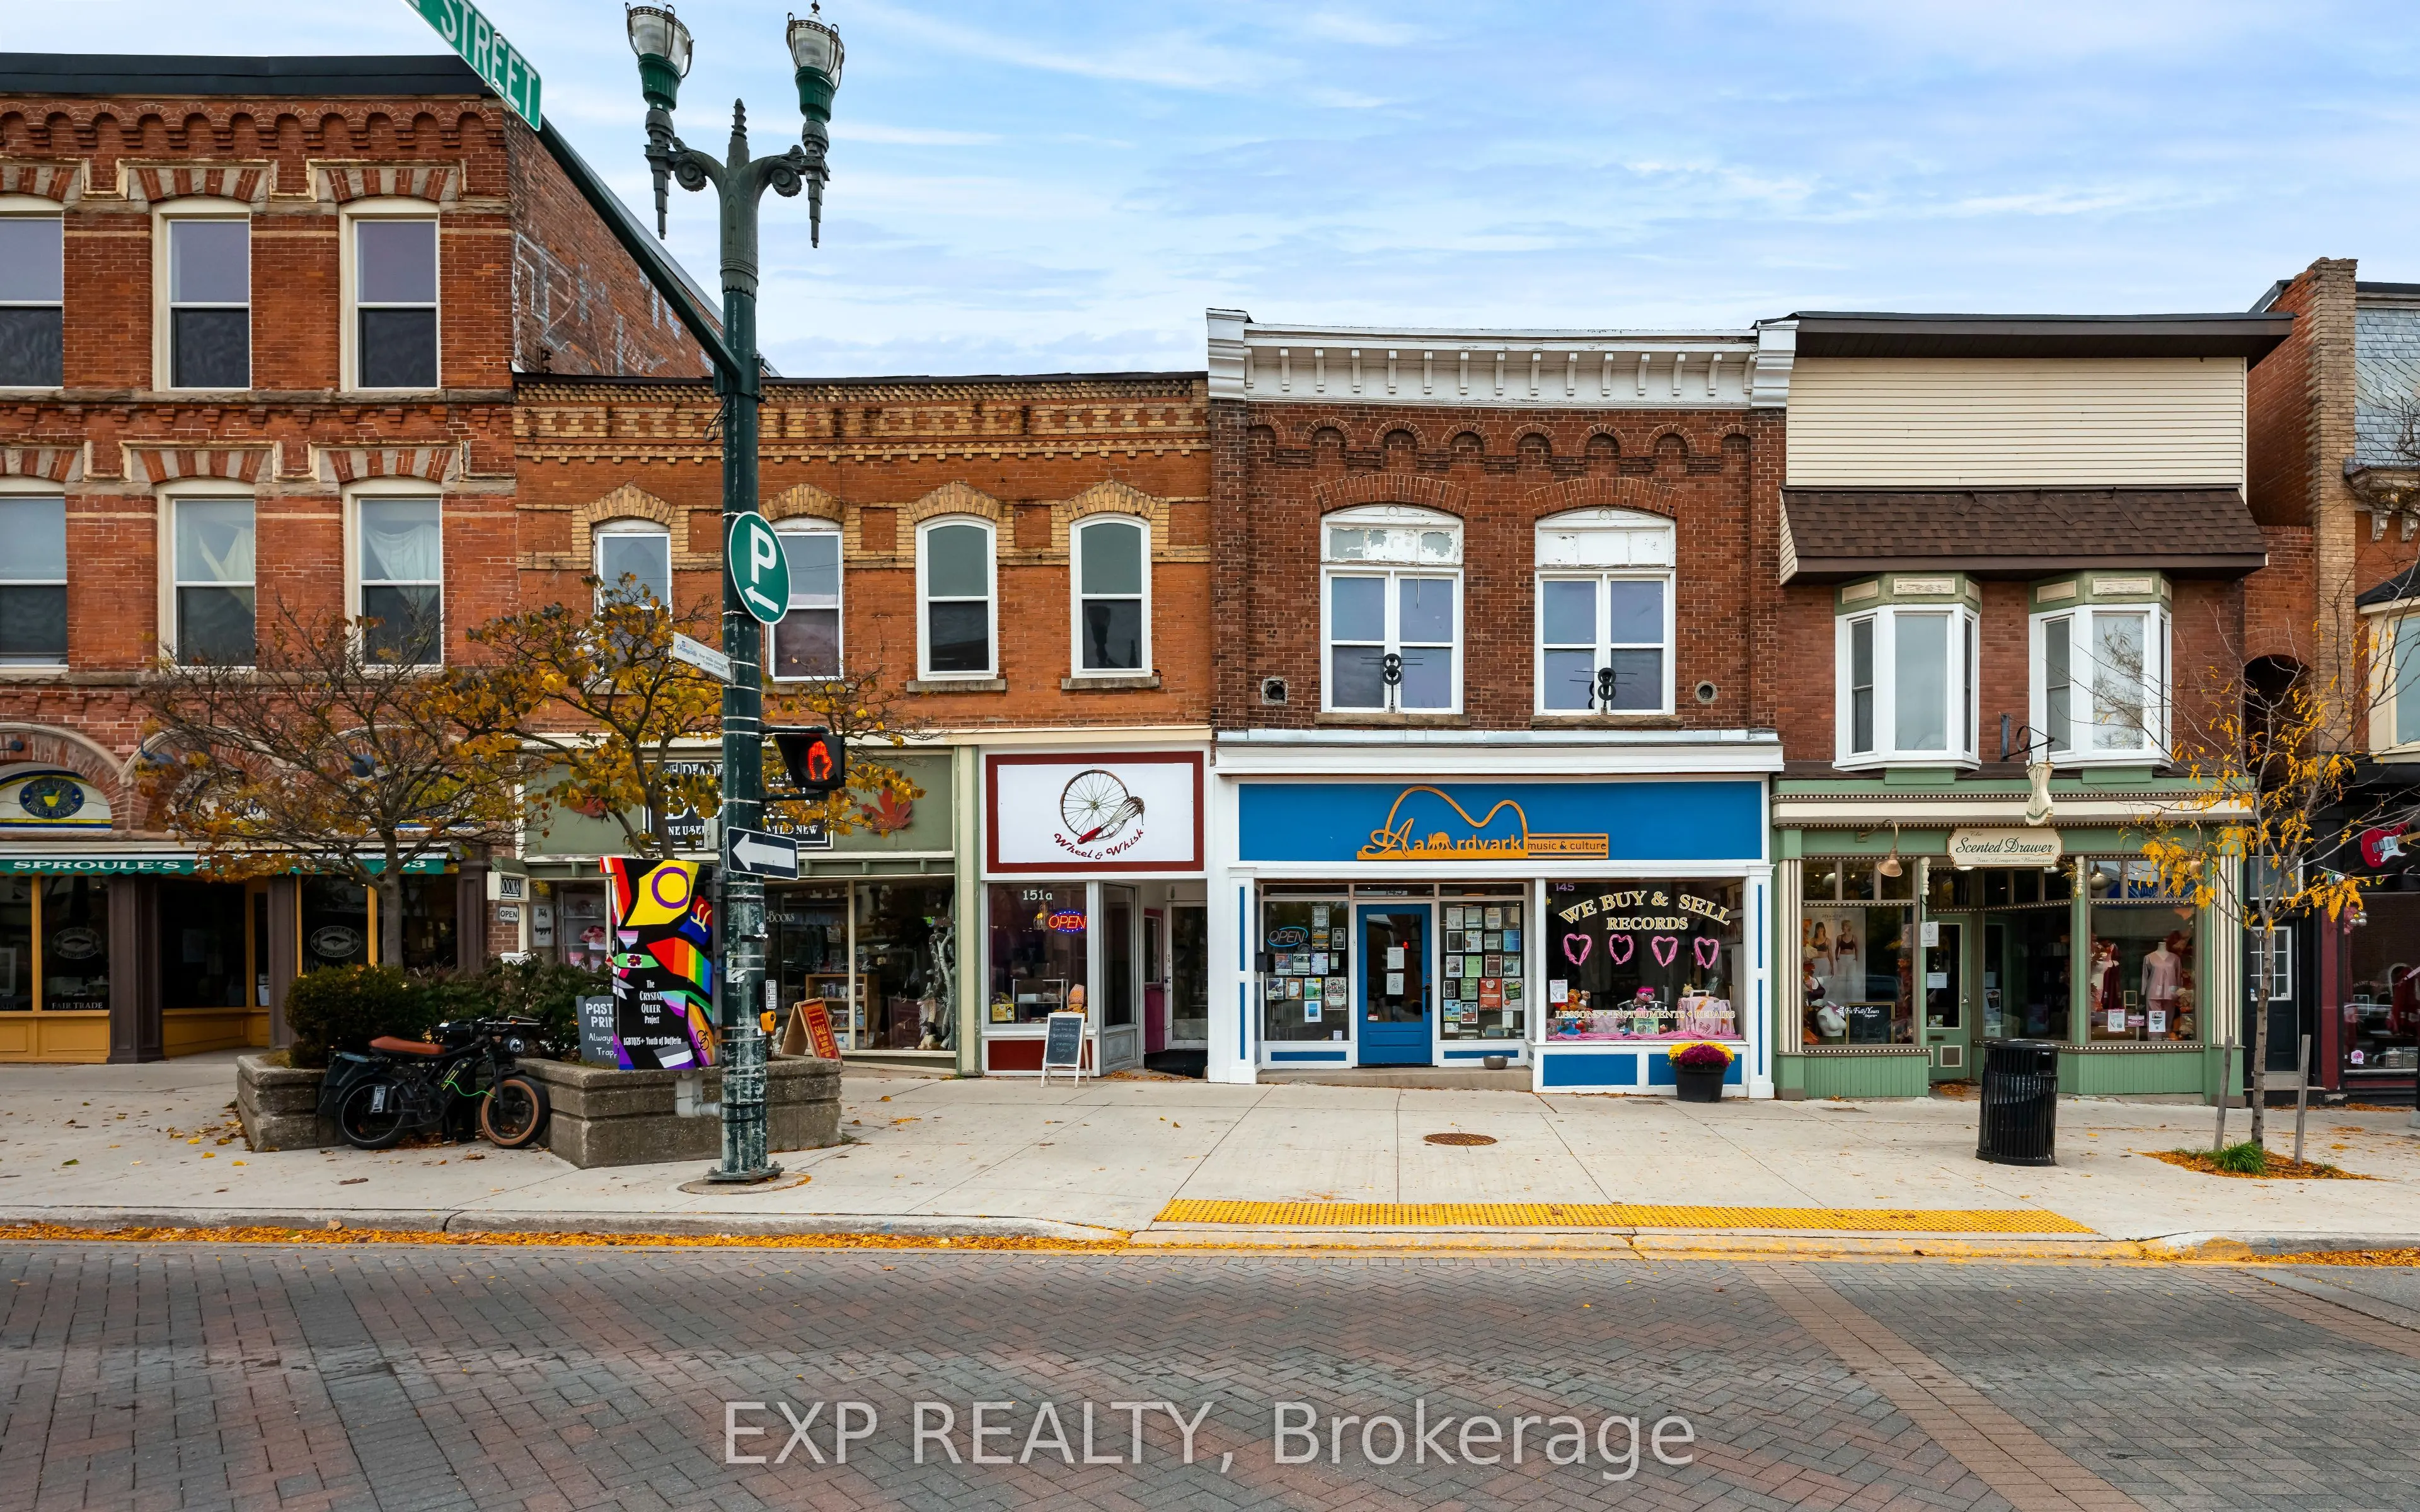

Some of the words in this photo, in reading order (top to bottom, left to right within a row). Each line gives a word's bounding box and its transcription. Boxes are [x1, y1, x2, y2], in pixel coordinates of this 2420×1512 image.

[441, 0, 536, 120] STREET
[683, 825, 705, 835] USE
[796, 825, 818, 835] NEW
[1054, 833, 1093, 858] Wheel
[1106, 829, 1143, 856] Whisk
[1528, 841, 1557, 849] music
[1560, 840, 1567, 849] &
[1570, 841, 1606, 849] culture
[1956, 837, 2003, 853] Scented
[2004, 837, 2056, 853] Drawer
[13, 861, 181, 870] SPROULE'S
[501, 879, 520, 894] OOKS
[1555, 883, 1574, 891] 145
[1023, 890, 1052, 900] 151a
[1559, 900, 1597, 924] WE
[1599, 891, 1647, 911] BUY
[1651, 891, 1669, 907] &
[1679, 894, 1731, 925] SELL
[500, 910, 517, 918] OPEN
[1048, 915, 1086, 929] OPEN
[1606, 917, 1688, 931] RECORDS
[1269, 930, 1305, 943] OPEN
[647, 980, 655, 988] The
[639, 990, 664, 1001] CRYSTAL
[585, 1003, 613, 1014] PAST
[641, 1003, 661, 1014] QUEER
[1853, 1007, 1866, 1015] Fully
[1866, 1006, 1880, 1014] Yours
[644, 1016, 660, 1024] Project
[1555, 1010, 1601, 1019] LESSONS
[1611, 1010, 1686, 1019] INSTRUMENTS
[1695, 1011, 1736, 1019] REPAIRS
[814, 1024, 827, 1036] SALE
[589, 1033, 613, 1044] Always
[646, 1036, 657, 1045] Youth
[659, 1037, 663, 1046] of
[664, 1036, 681, 1046] Dufferin
